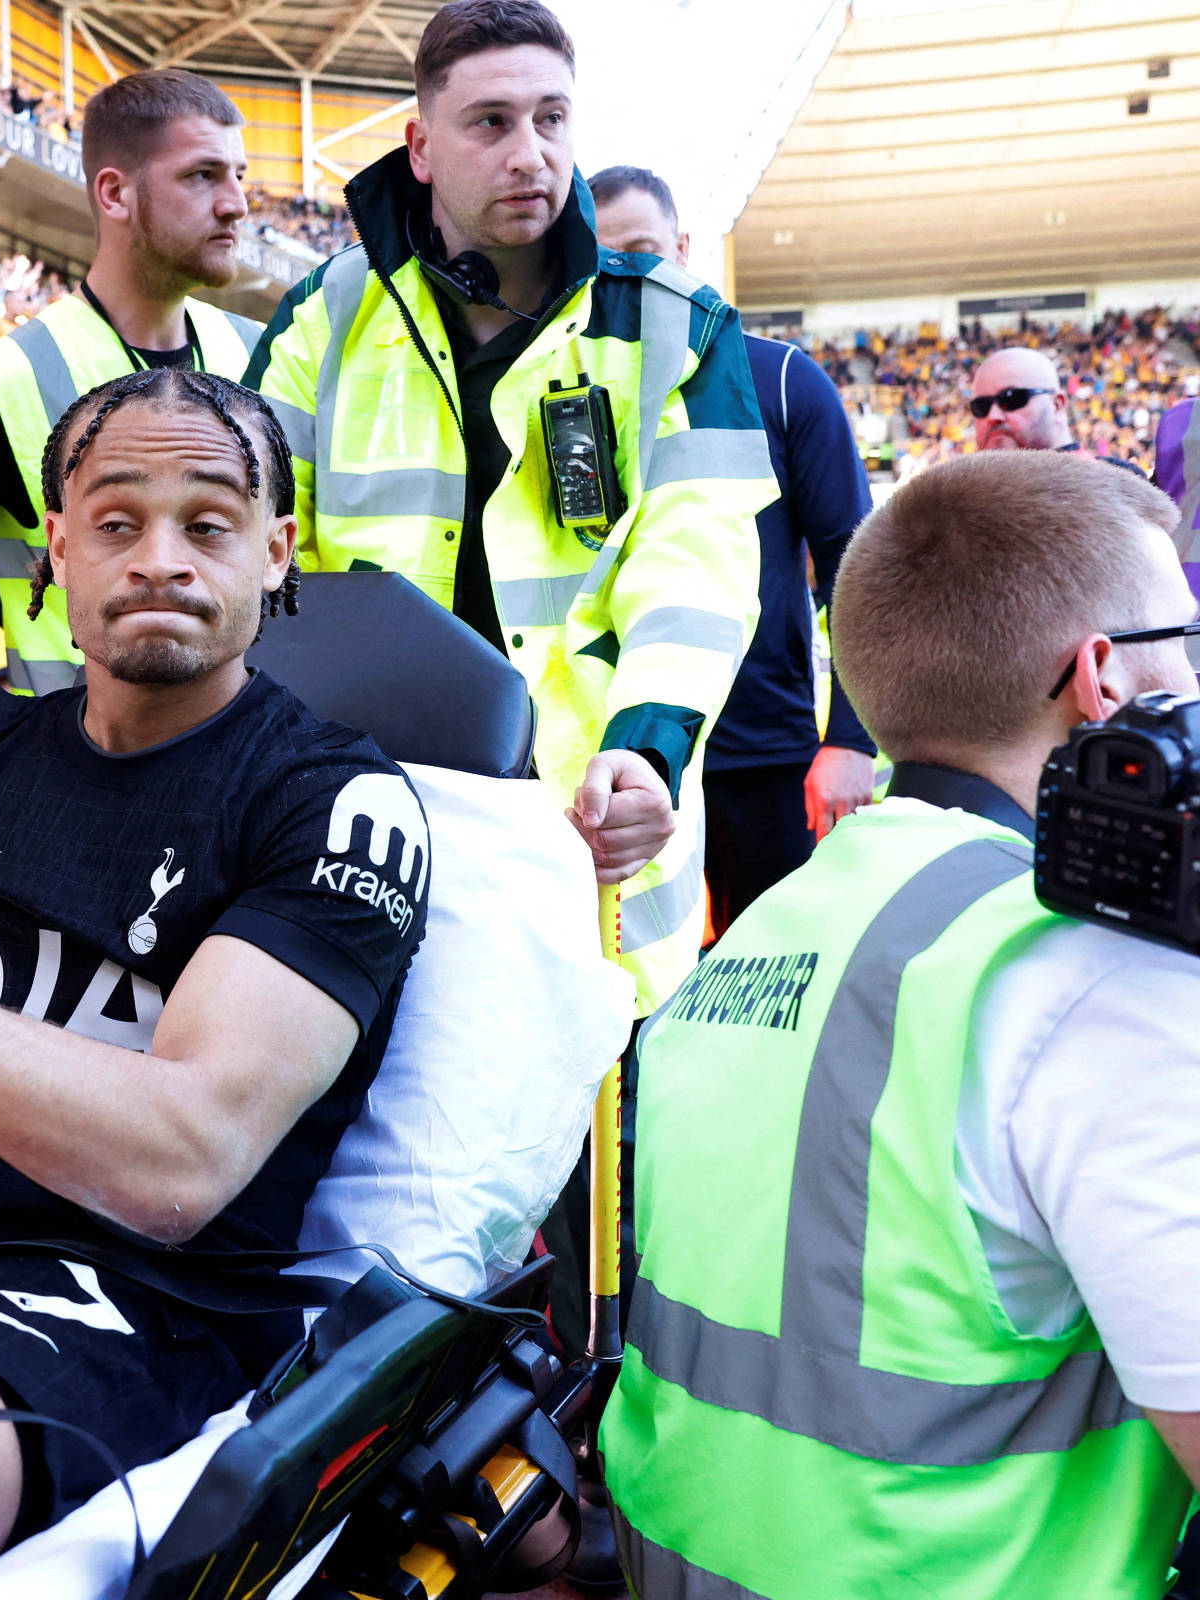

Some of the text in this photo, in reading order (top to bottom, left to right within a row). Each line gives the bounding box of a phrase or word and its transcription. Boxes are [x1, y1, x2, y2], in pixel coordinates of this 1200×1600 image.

[41, 136, 87, 180] LOV
[310, 856, 414, 938] kraken
[668, 952, 819, 1032] PHOTOGRAPHER
